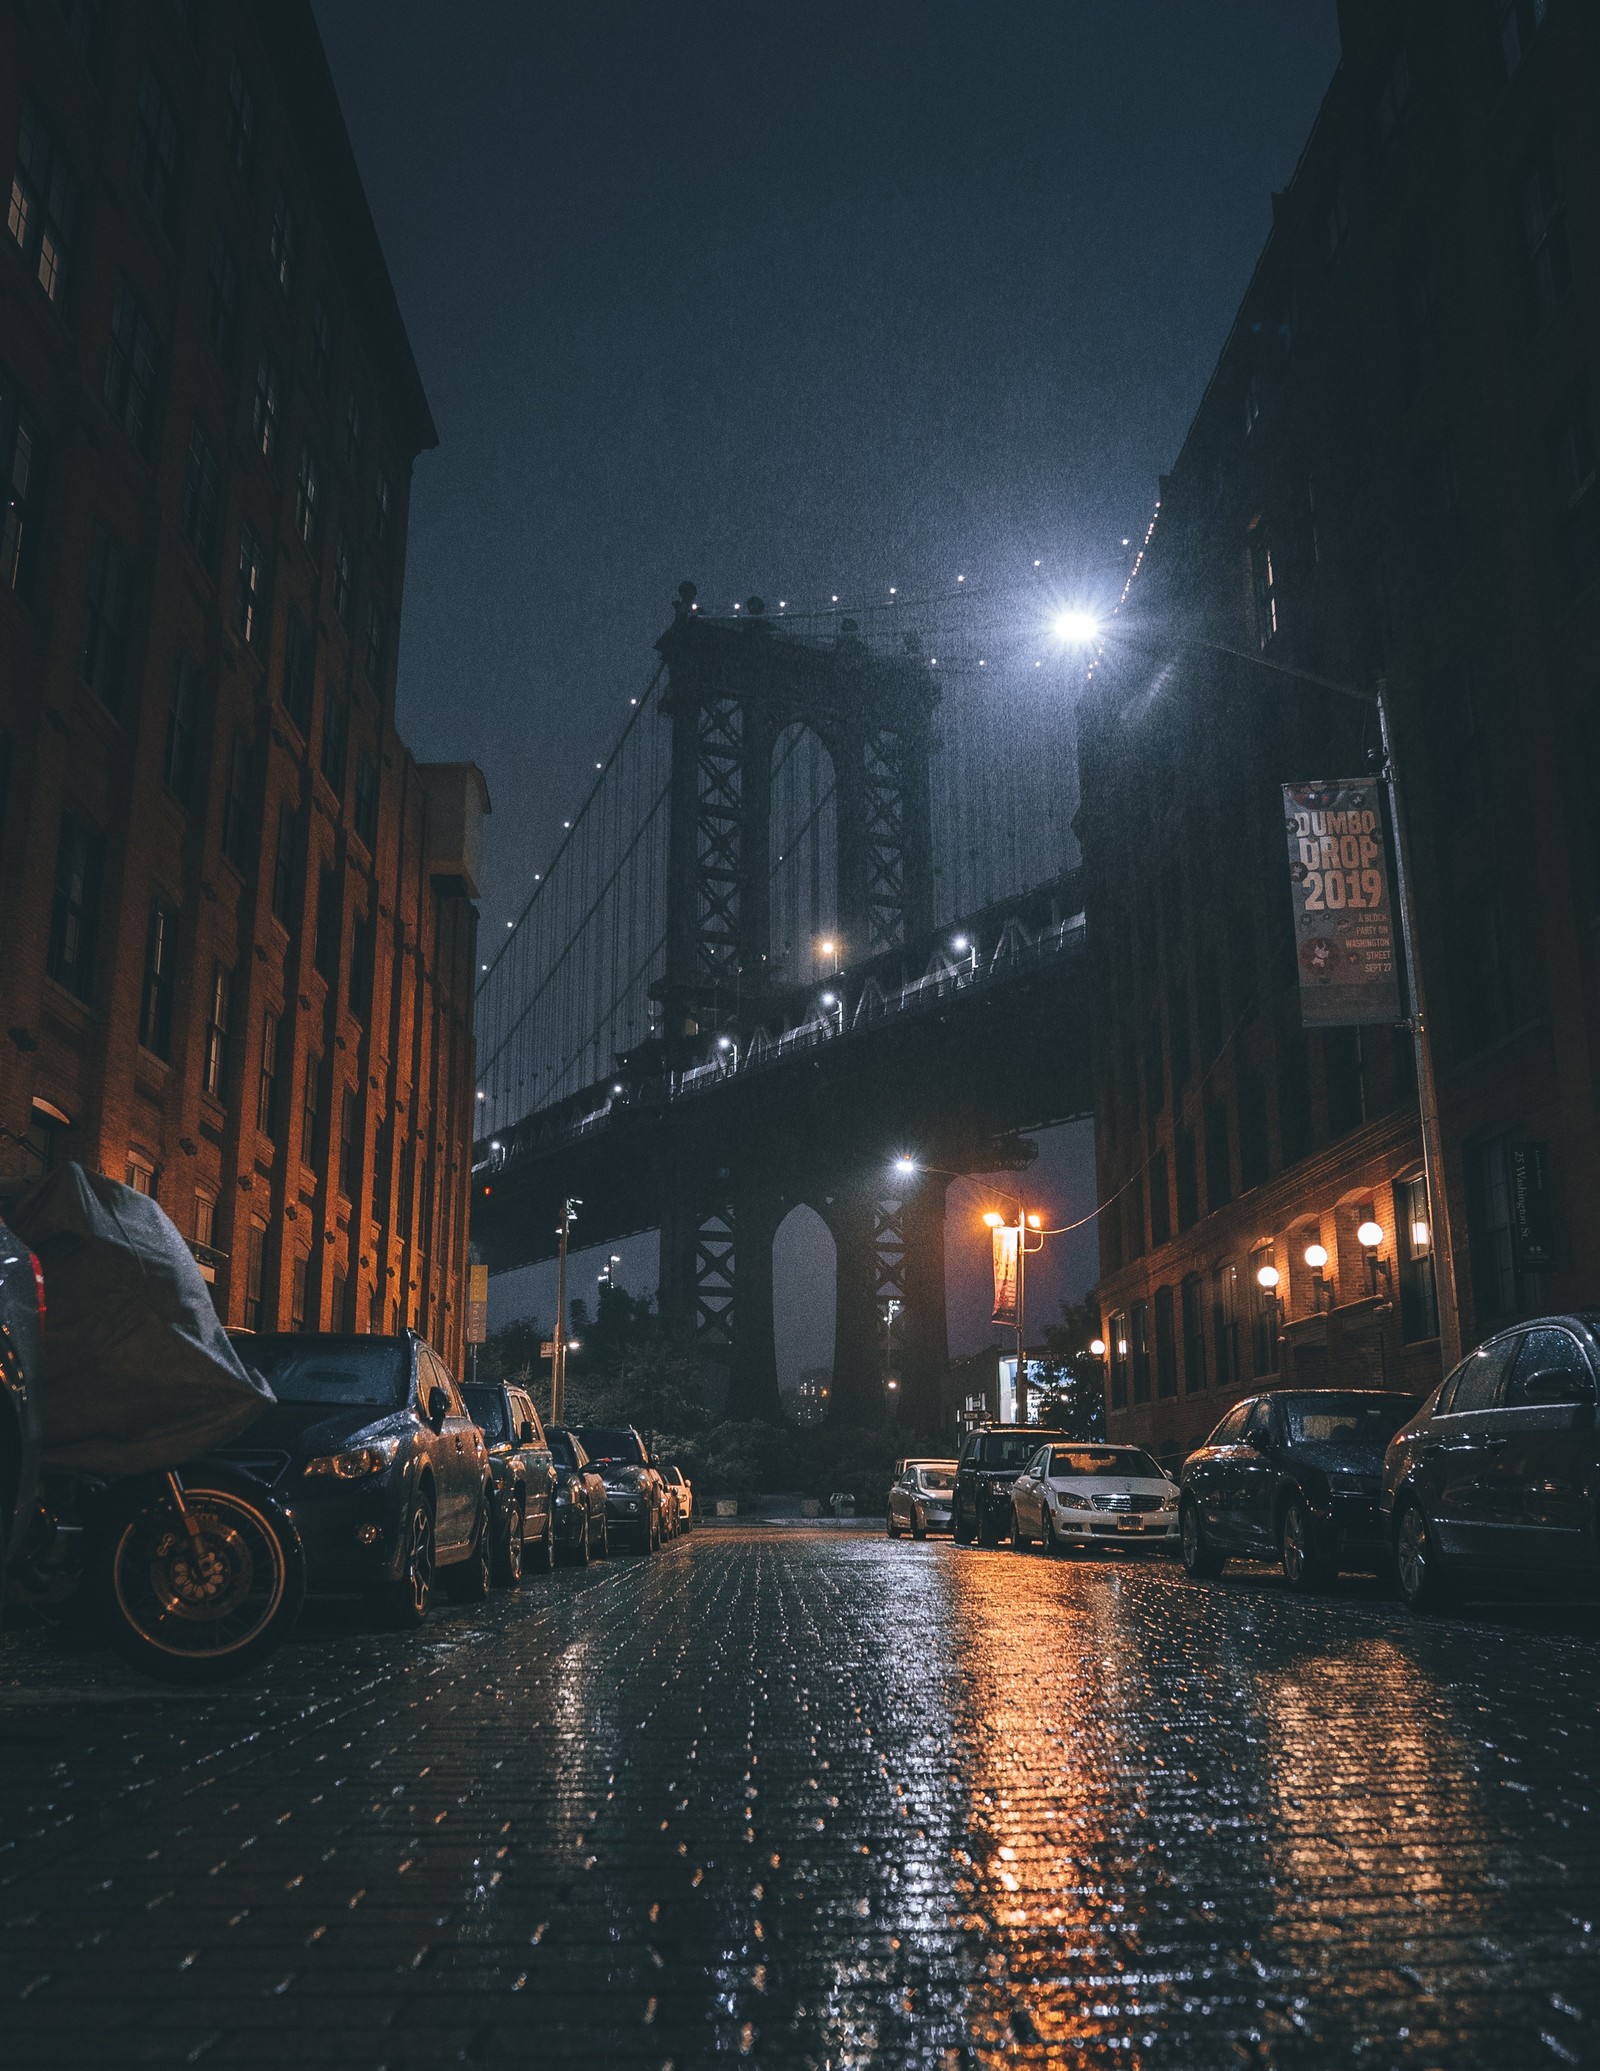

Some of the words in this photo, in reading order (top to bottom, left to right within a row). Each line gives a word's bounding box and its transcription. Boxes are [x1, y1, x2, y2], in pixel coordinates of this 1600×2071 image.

[1295, 811, 1376, 837] DUMBO
[1299, 835, 1377, 870] DROP
[1303, 870, 1381, 910] 2019
[1364, 913, 1387, 923] BLOCK
[1356, 925, 1377, 936] PARTY
[1378, 925, 1388, 934] ON
[1345, 938, 1390, 948] WASHINGTON
[1366, 950, 1391, 960] STREET
[1364, 963, 1382, 973] SEPT
[1383, 962, 1392, 972] 27
[1514, 1151, 1524, 1163] 25
[1516, 1166, 1527, 1224] Washington
[1520, 1227, 1531, 1240] St.
